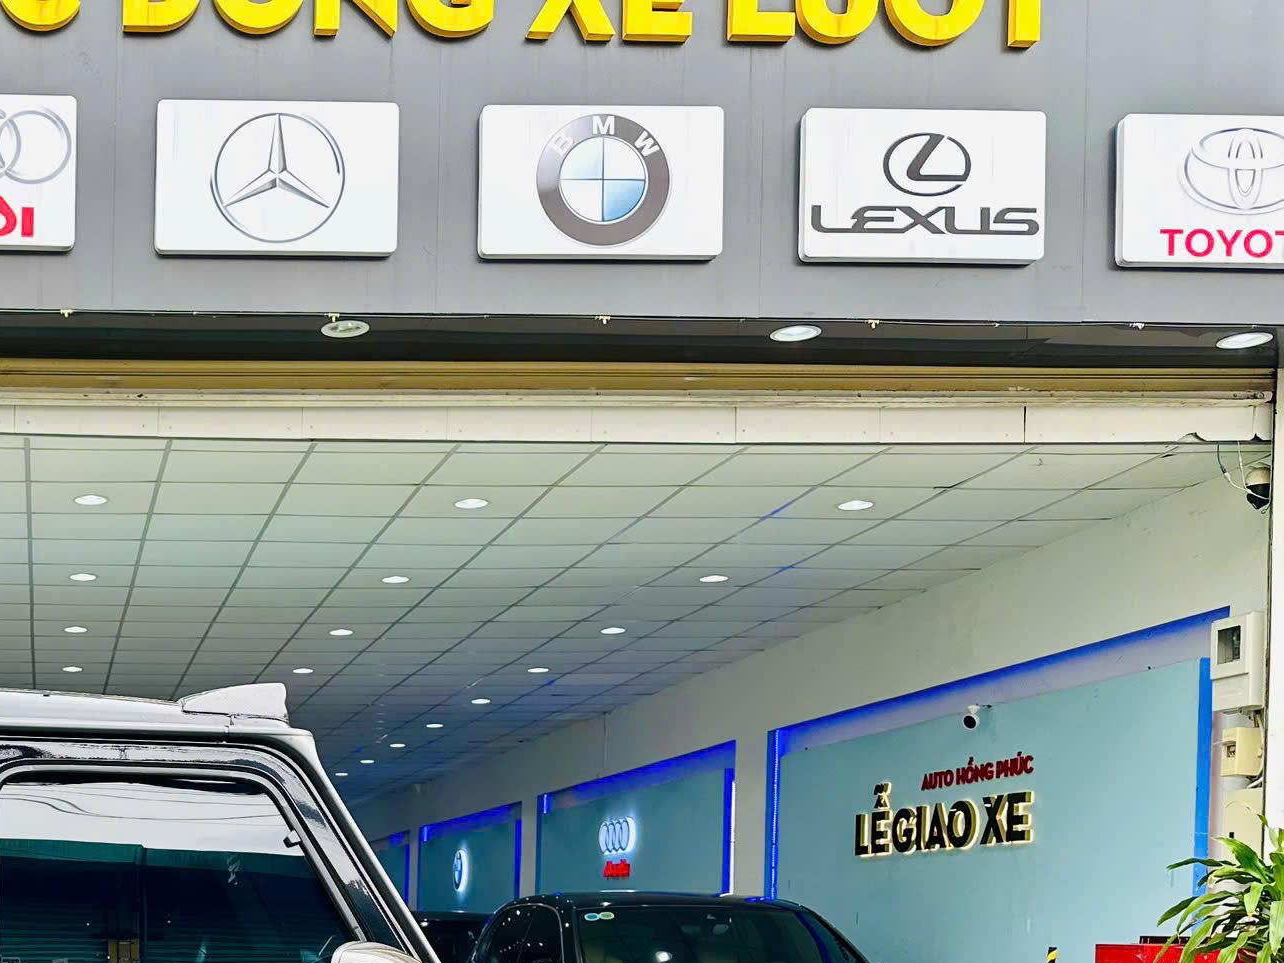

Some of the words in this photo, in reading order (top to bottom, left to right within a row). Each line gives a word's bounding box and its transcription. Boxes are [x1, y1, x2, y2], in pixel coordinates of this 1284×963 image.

[548, 114, 662, 158] BMW
[810, 204, 1040, 236] LEXUS
[921, 769, 955, 791] AUTO
[995, 751, 1035, 779] PHÚC
[854, 782, 893, 857] LỄ
[891, 800, 980, 854] GIAO
[979, 790, 1035, 846] XE
